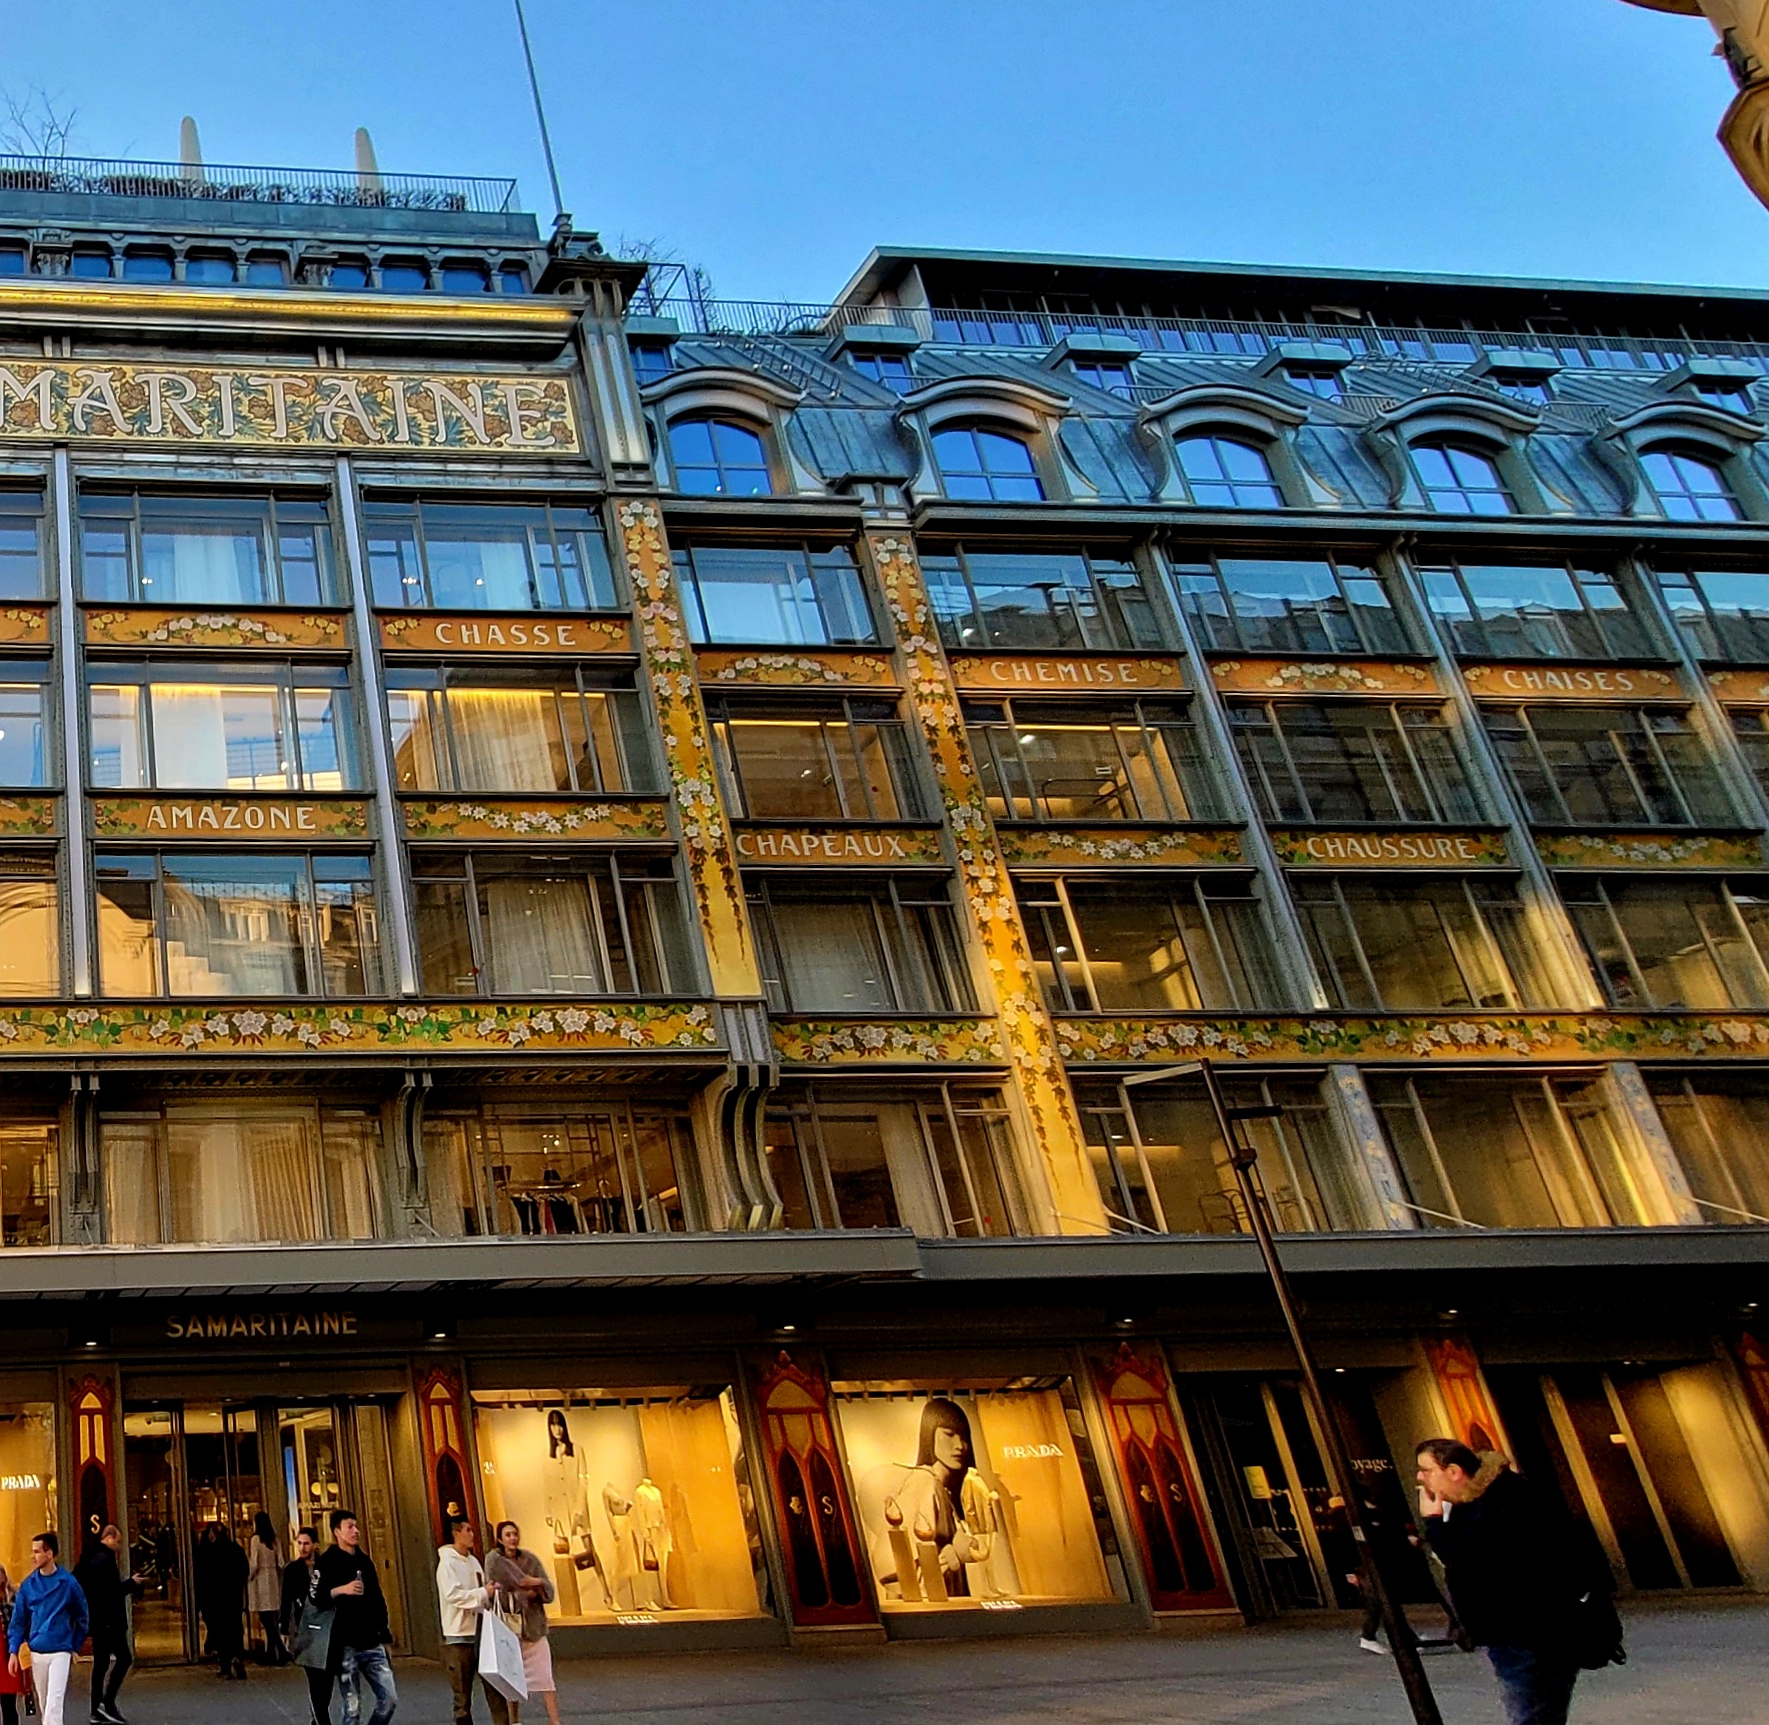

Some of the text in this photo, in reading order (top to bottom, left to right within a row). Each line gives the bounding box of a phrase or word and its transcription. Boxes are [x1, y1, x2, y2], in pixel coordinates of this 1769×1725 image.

[435, 623, 576, 646] CHASSE
[990, 661, 1138, 683] CHEMISE
[1503, 670, 1633, 691] CHAISES
[147, 805, 316, 830] AMAZONE
[736, 834, 906, 857] CHAPEAUX
[1307, 837, 1476, 860] CHAUSSURE
[165, 1310, 358, 1338] SAMARITAINE
[1003, 1443, 1064, 1458] PRADA
[1, 1474, 41, 1490] PRADA
